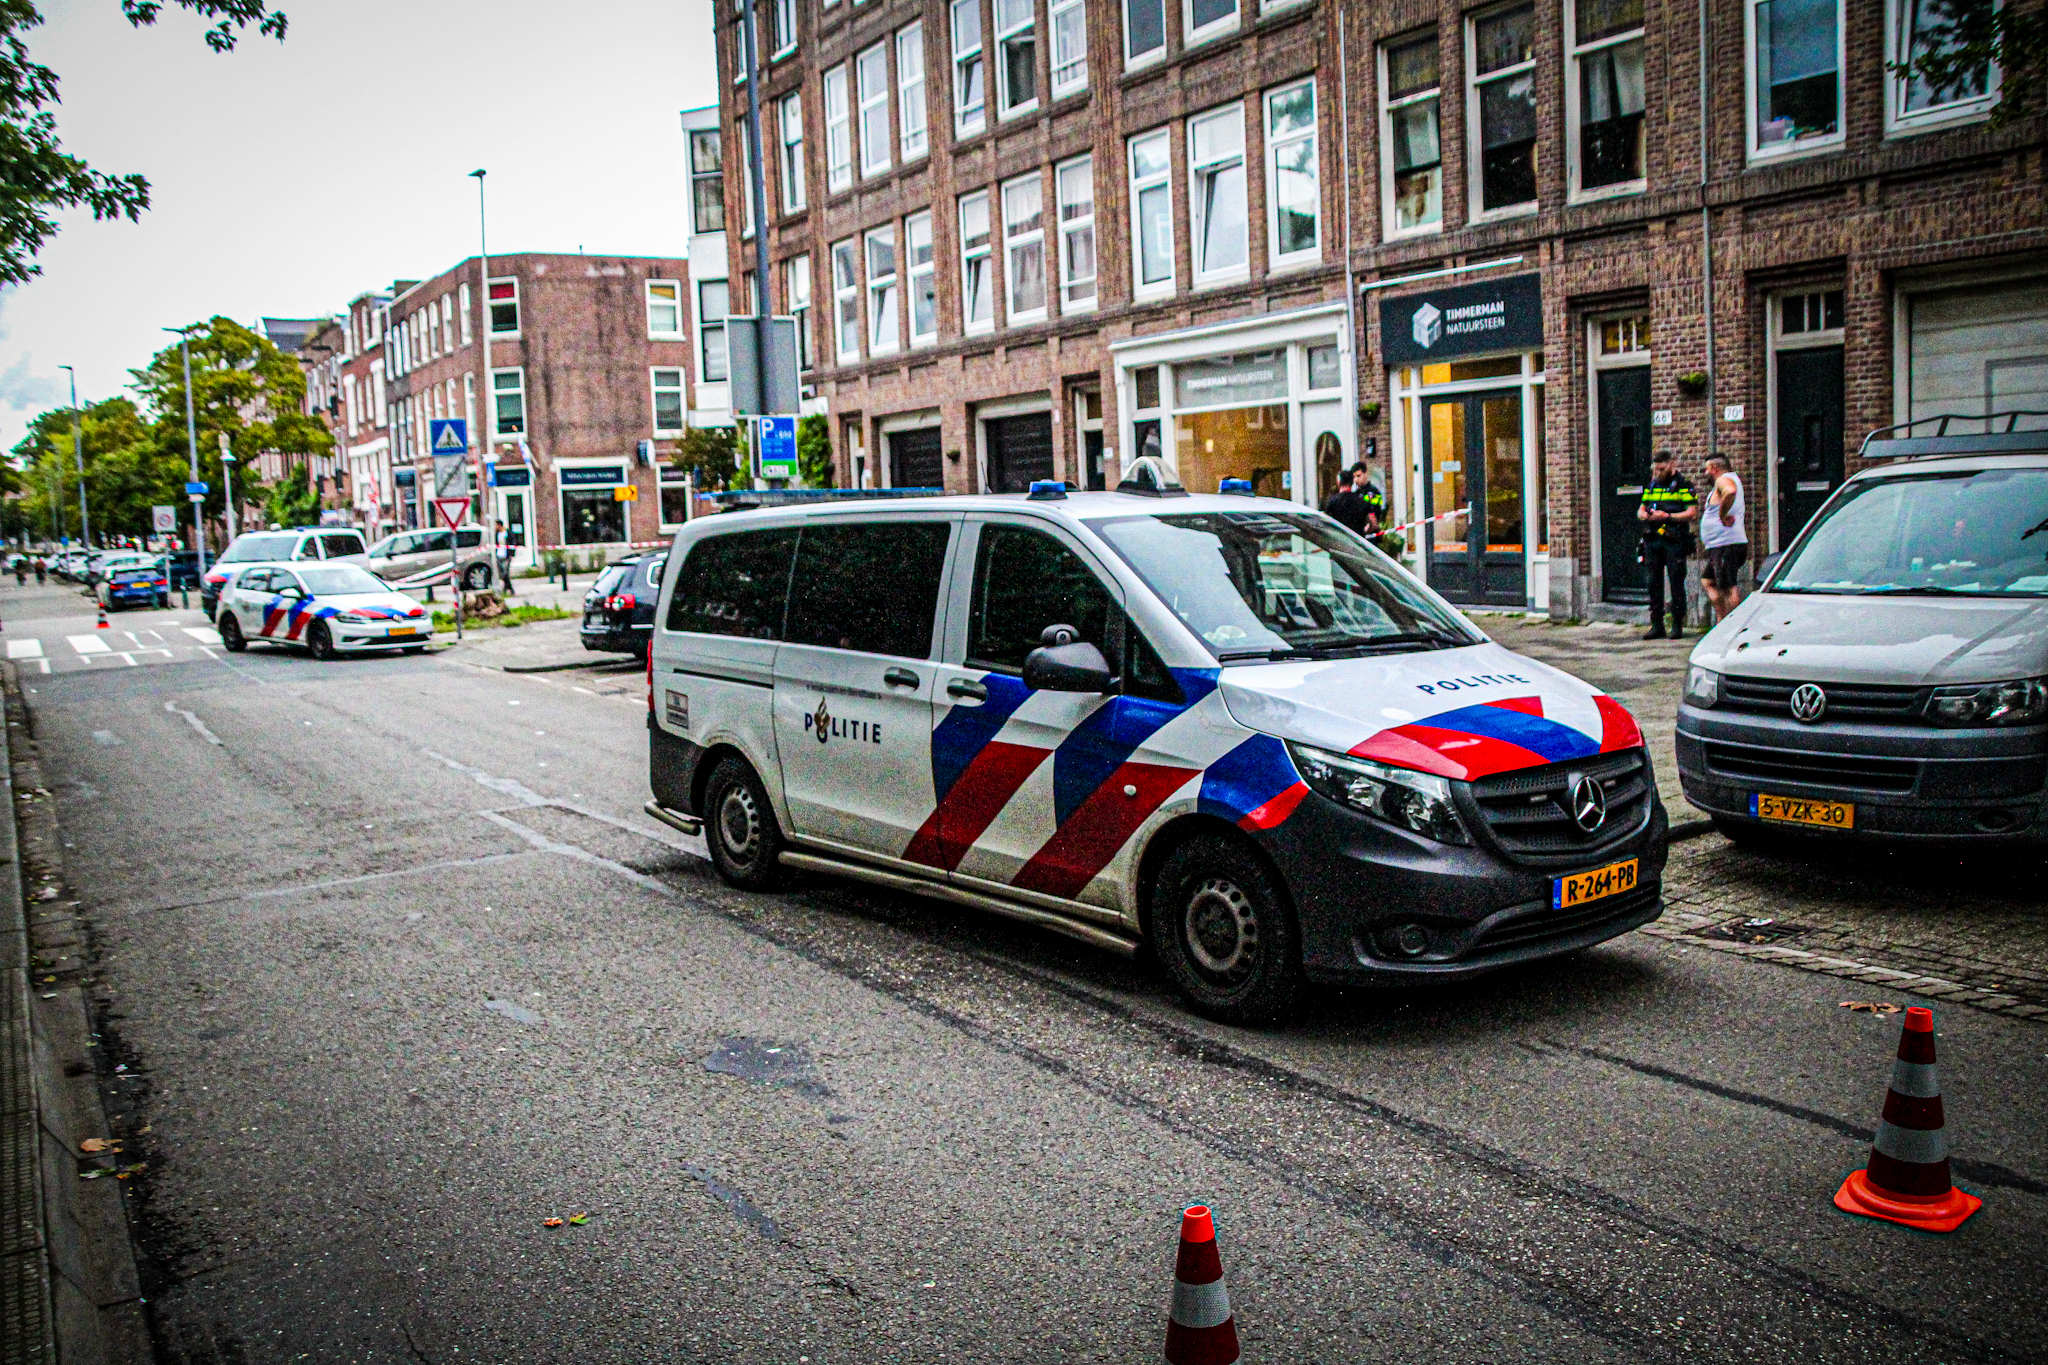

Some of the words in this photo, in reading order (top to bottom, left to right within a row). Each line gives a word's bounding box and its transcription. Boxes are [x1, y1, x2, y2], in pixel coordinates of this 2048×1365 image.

[1446, 301, 1504, 320] TIMMERMAN
[1446, 316, 1505, 335] NATUURSTEEN
[761, 418, 775, 439] P
[1416, 674, 1530, 695] POLITIE
[1761, 798, 1844, 823] 5-VZK-30
[1568, 864, 1634, 902] R-264-PB
